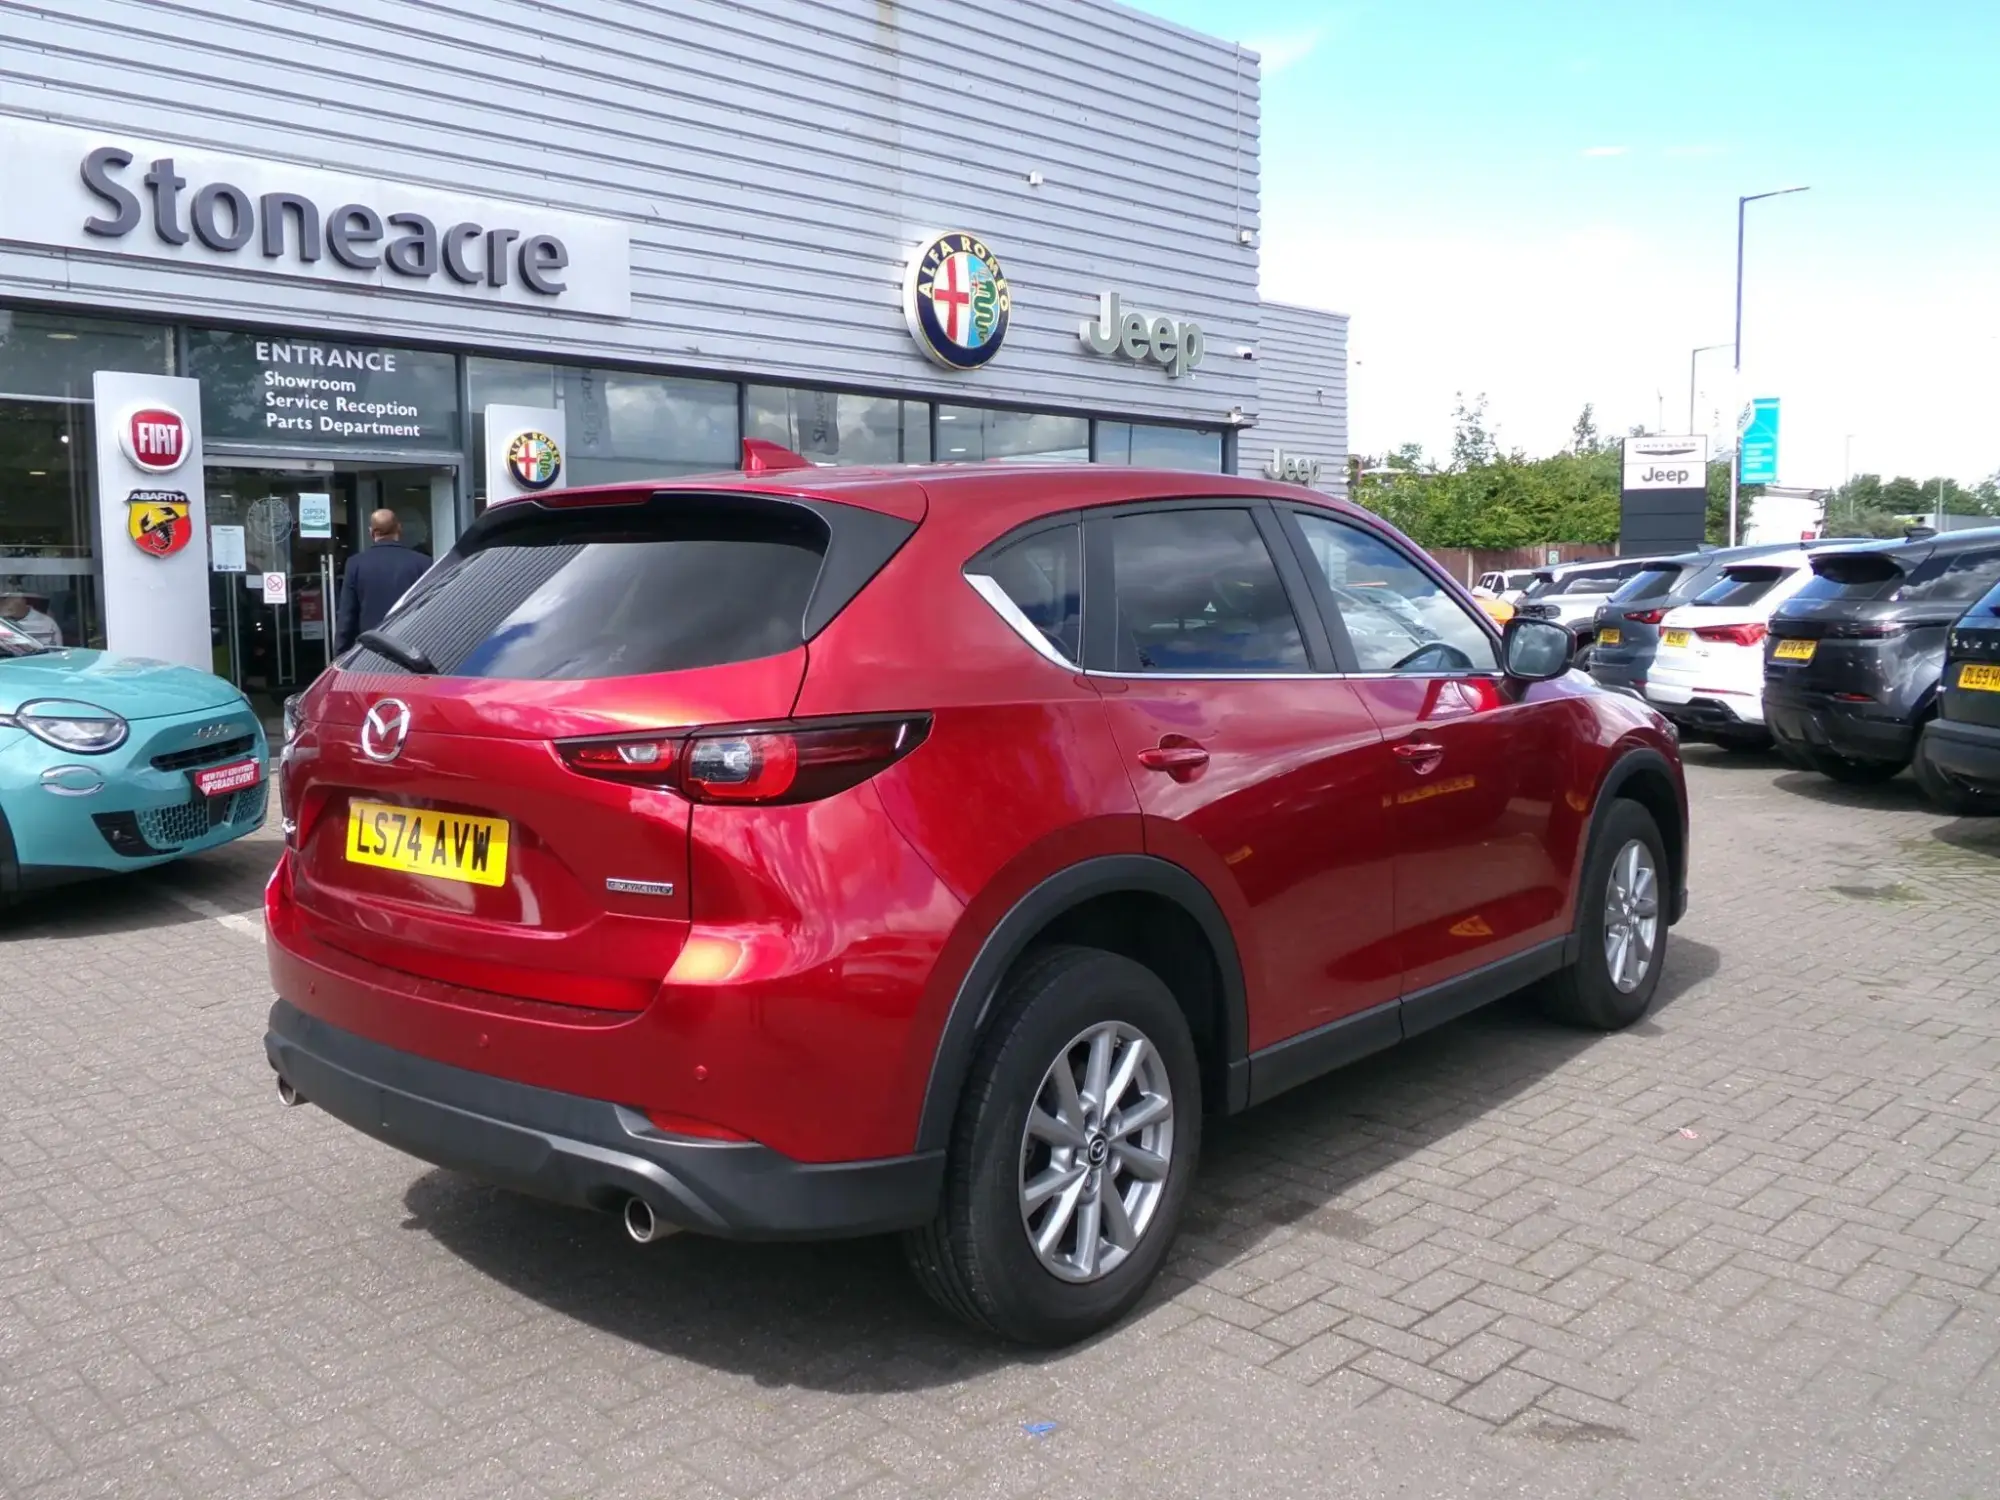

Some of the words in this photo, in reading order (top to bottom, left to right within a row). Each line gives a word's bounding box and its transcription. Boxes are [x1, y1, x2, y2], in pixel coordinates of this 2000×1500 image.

[80, 146, 570, 296] Stoneacre
[918, 240, 955, 299] ALFA
[960, 236, 1009, 312] ROMEO
[1079, 290, 1204, 379] Jeep
[255, 341, 397, 373] ENTRANCE
[264, 370, 357, 393] Showroom
[265, 391, 329, 411] Service
[336, 396, 418, 418] Reception
[136, 422, 179, 455] FIAT
[266, 412, 313, 431] Parts
[319, 416, 421, 437] Department
[509, 434, 529, 462] ALFA
[531, 431, 561, 465] ROMEO
[1264, 448, 1321, 488] Jeep
[1641, 467, 1689, 485] Jeep
[130, 492, 185, 503] ABARTH
[357, 809, 422, 862] LS74
[431, 819, 491, 872] AVW
